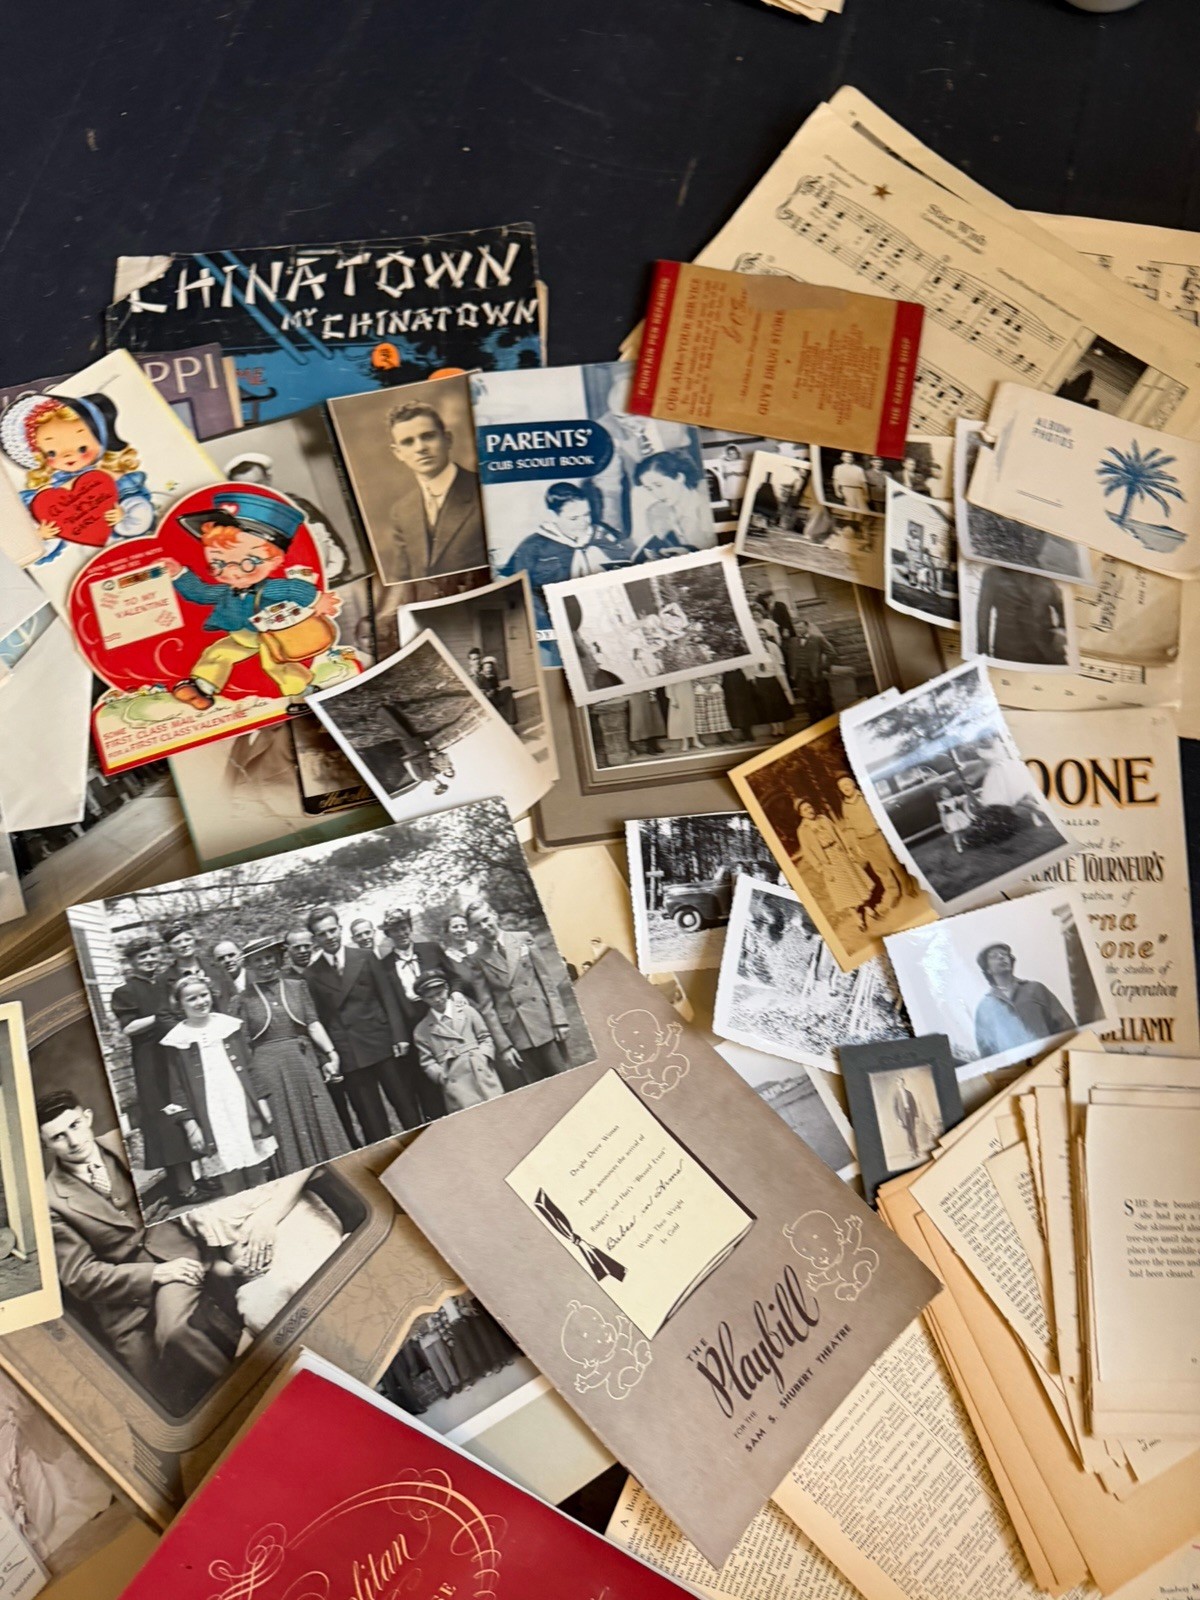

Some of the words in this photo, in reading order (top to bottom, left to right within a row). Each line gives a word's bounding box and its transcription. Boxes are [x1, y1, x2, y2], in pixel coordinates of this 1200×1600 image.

[651, 276, 670, 324] REPAIRING
[281, 307, 318, 332] MY
[322, 298, 538, 340] CHINATOWN
[647, 325, 660, 344] PEN
[769, 309, 786, 344] STORE
[664, 385, 680, 411] OUR
[683, 277, 700, 319] SERVICE
[896, 336, 912, 363] SHOP
[637, 347, 655, 396] FOUNTAIN
[762, 347, 779, 379] DRUG
[890, 365, 907, 404] CAMERA
[888, 407, 901, 425] THE
[488, 459, 514, 471] CUB
[516, 457, 556, 469] SCOUT
[559, 455, 595, 467] BOOK
[113, 598, 169, 619] VALENTINE
[102, 727, 126, 740] SOME
[104, 734, 132, 749] FIRST
[135, 723, 168, 739] CLASS
[170, 714, 195, 727] MAIL
[129, 736, 158, 750] FIRST
[158, 726, 191, 742] CLASS
[192, 709, 247, 731] VALENTINE
[1060, 818, 1100, 827] ALLAD
[1110, 979, 1179, 1002] Corporation
[615, 1153, 626, 1164] the
[685, 1337, 709, 1362] THE
[695, 1264, 820, 1419] Playbill
[743, 1427, 767, 1453] SAM
[776, 1367, 816, 1409] SHUBERT
[813, 1323, 854, 1365] THEATRE
[732, 1423, 748, 1440] FOR
[743, 1409, 759, 1425] THE
[619, 1517, 629, 1527] A
[624, 1485, 641, 1512] Book
[635, 1499, 649, 1525] uncle's
[643, 1505, 655, 1524] With
[649, 1533, 660, 1548] had
[738, 1560, 749, 1578] drew
[745, 1546, 754, 1558] off
[750, 1530, 760, 1547] into
[756, 1518, 765, 1530] the
[751, 1559, 766, 1588] resolute
[762, 1516, 783, 1559] government
[760, 1577, 767, 1585] of
[764, 1545, 781, 1575] princely
[776, 1521, 788, 1542] blood
[717, 1568, 731, 1592] proud
[726, 1552, 736, 1566] and
[738, 1561, 759, 1600] conspiracy
[754, 1534, 768, 1559] among
[763, 1513, 775, 1533] other
[782, 1553, 793, 1569] that
[724, 1563, 741, 1594] pacified.
[792, 1568, 804, 1588] when
